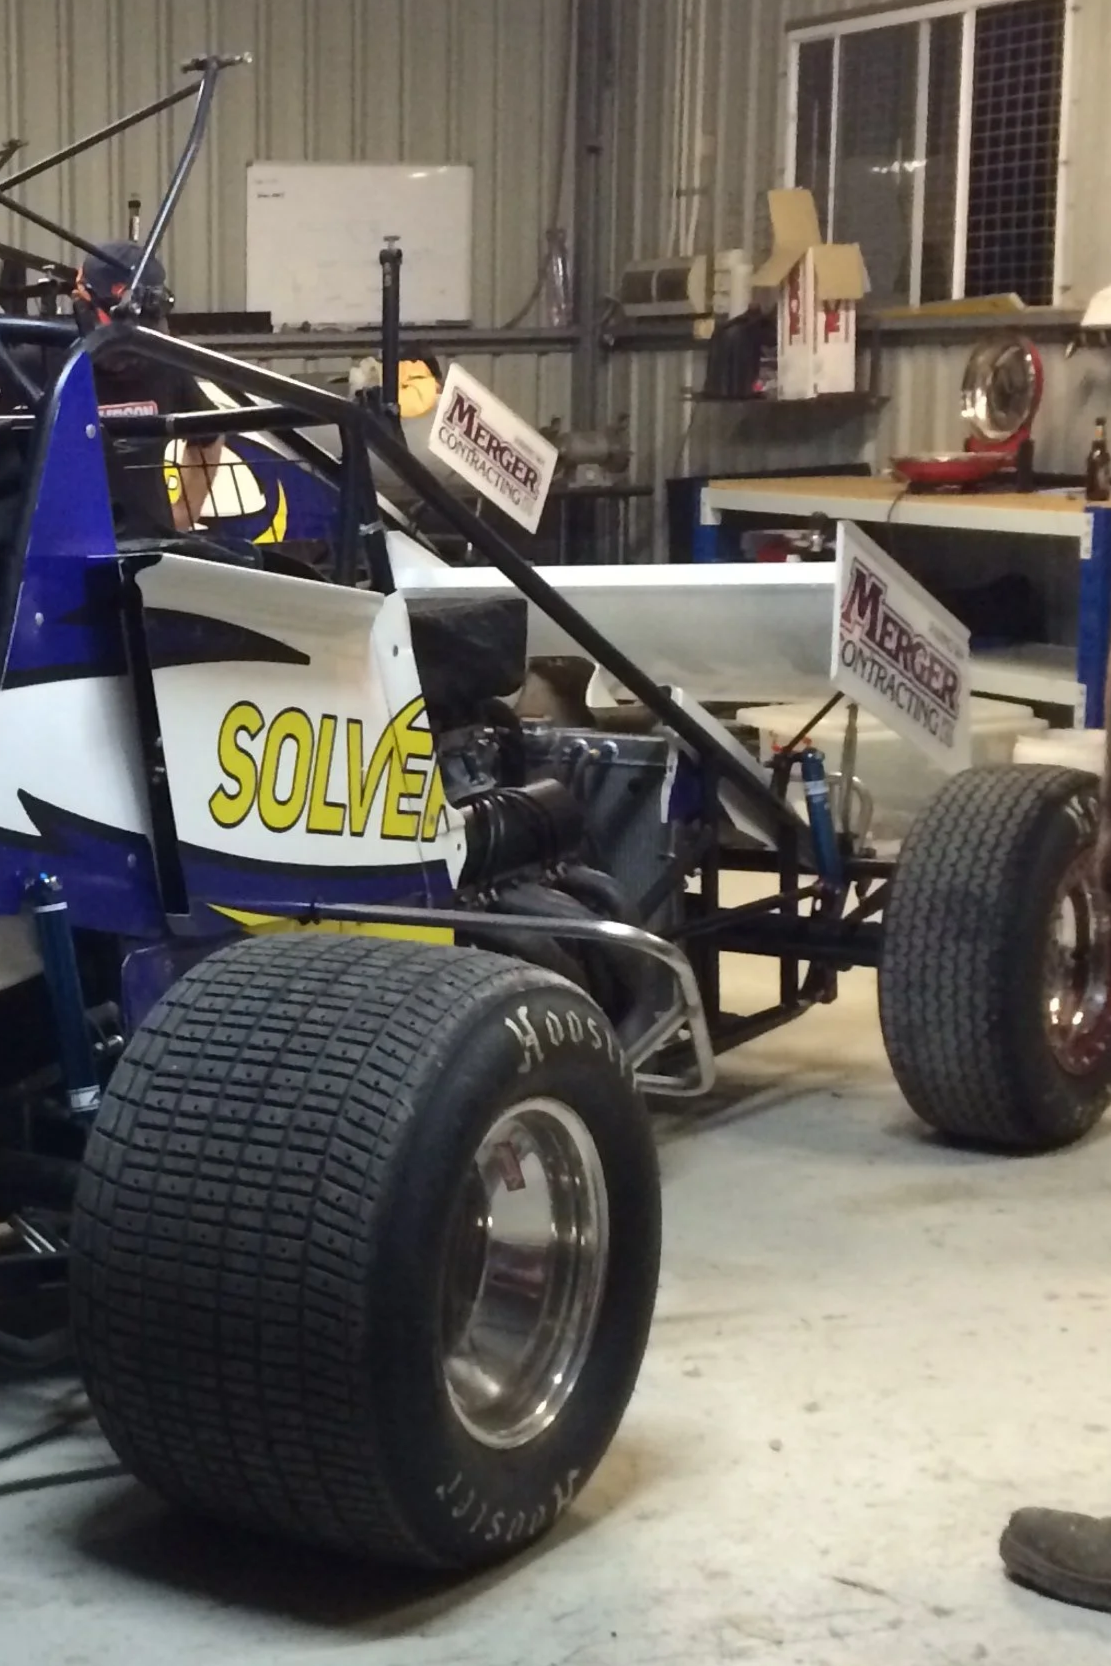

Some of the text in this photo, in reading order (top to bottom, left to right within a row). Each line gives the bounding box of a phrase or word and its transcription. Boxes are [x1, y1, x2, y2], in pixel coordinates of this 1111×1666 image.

[439, 427, 522, 506] CONTRACTING
[444, 384, 541, 497] MERGER
[841, 638, 940, 736] ONTRACTING
[842, 560, 960, 716] MERGER
